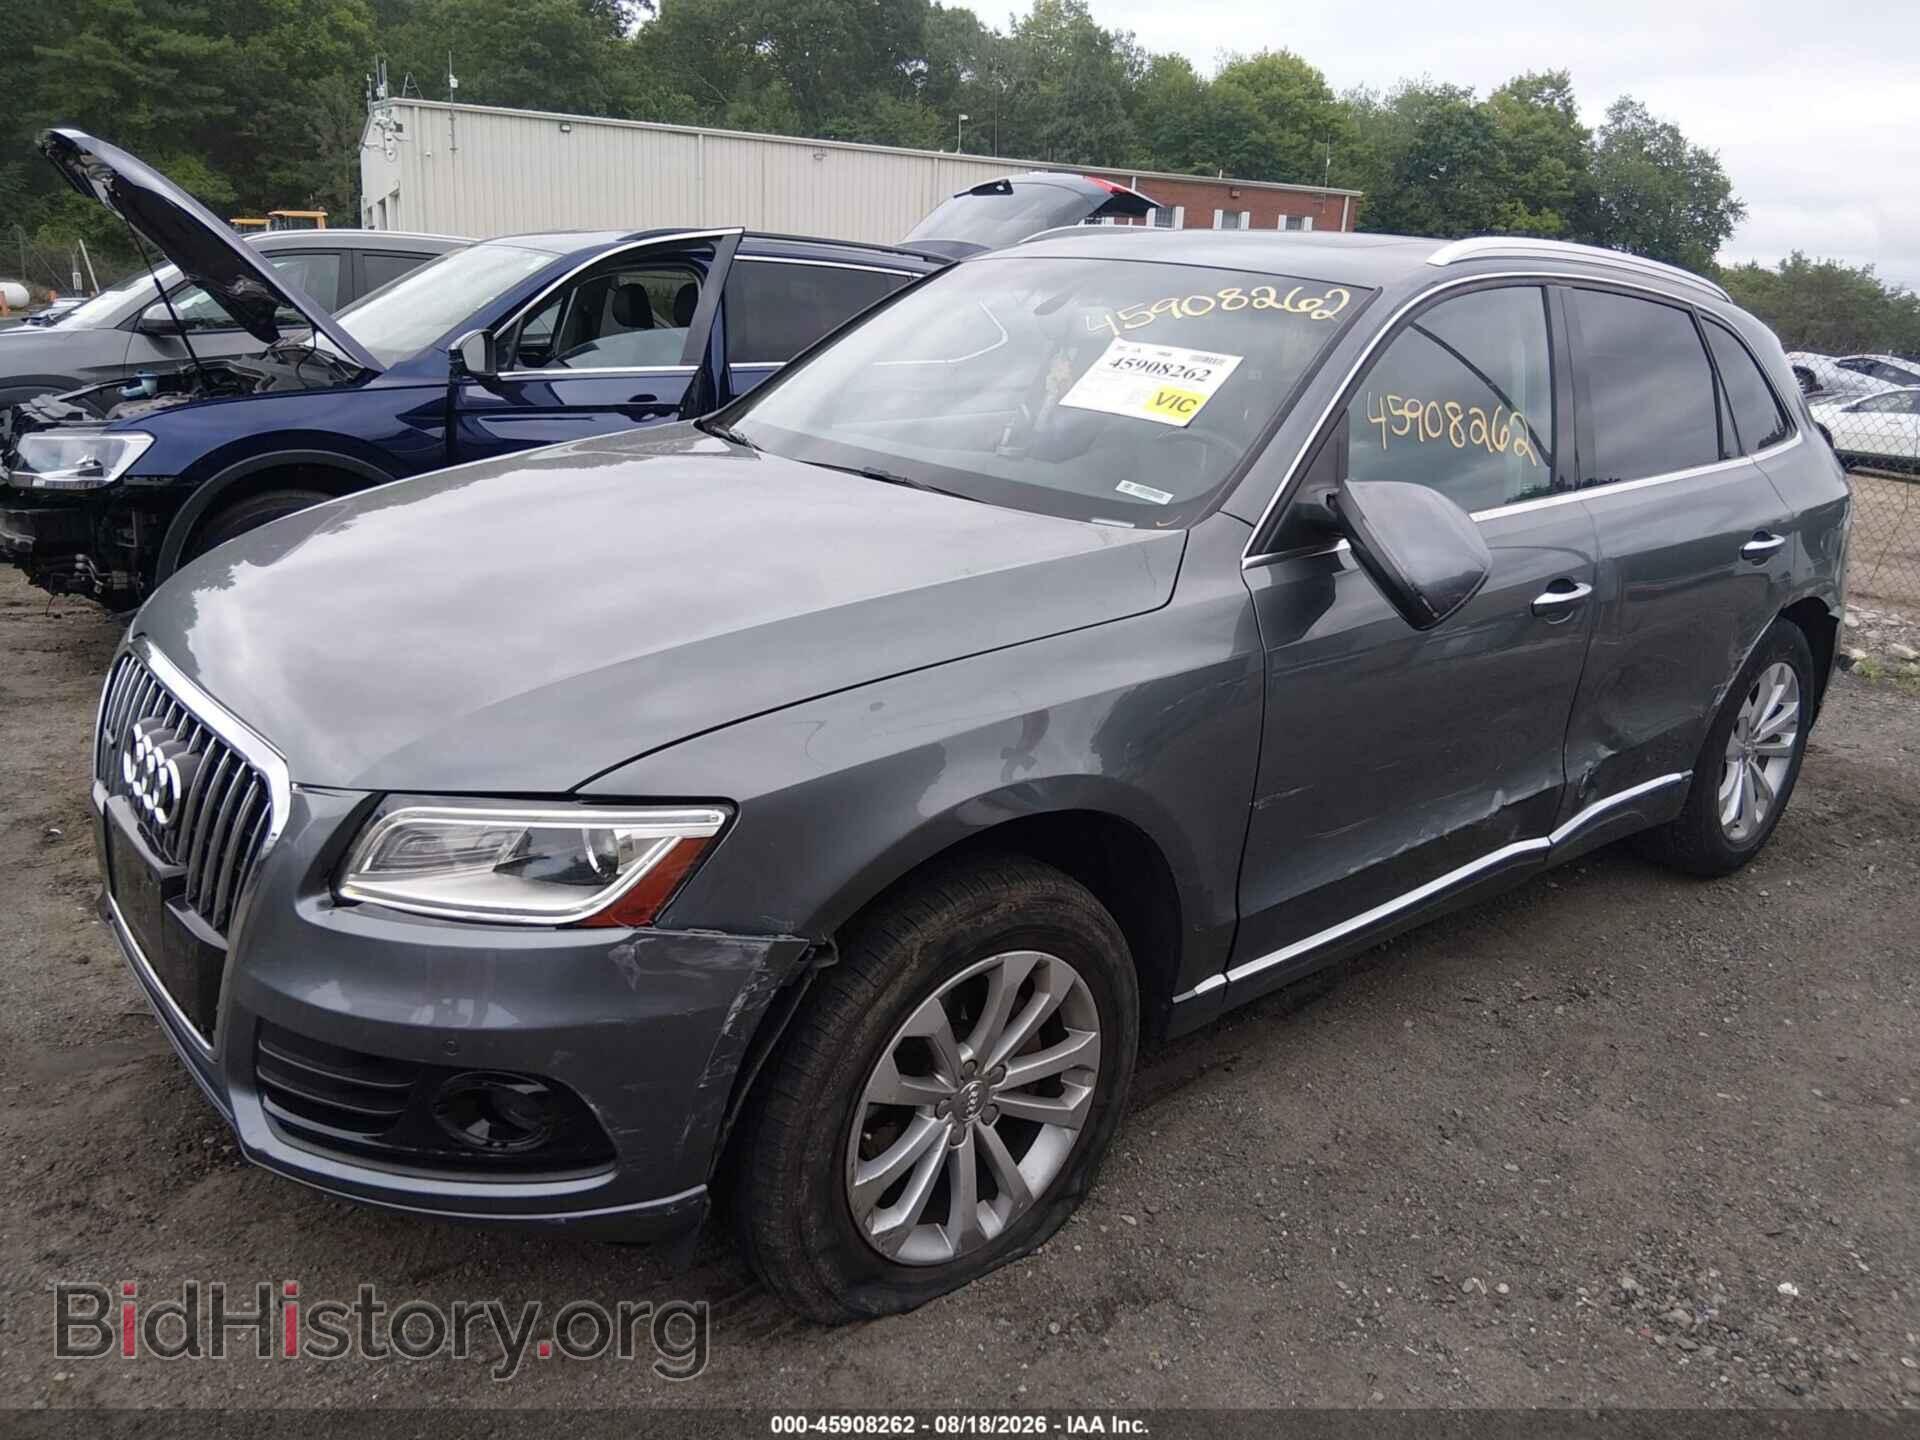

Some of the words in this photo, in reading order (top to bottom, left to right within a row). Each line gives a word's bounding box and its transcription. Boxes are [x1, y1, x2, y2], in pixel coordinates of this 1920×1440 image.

[1086, 286, 1351, 337] 45908262
[1109, 357, 1212, 382] 45908262
[1155, 391, 1198, 413] VIC
[1367, 391, 1537, 466] 45908262
